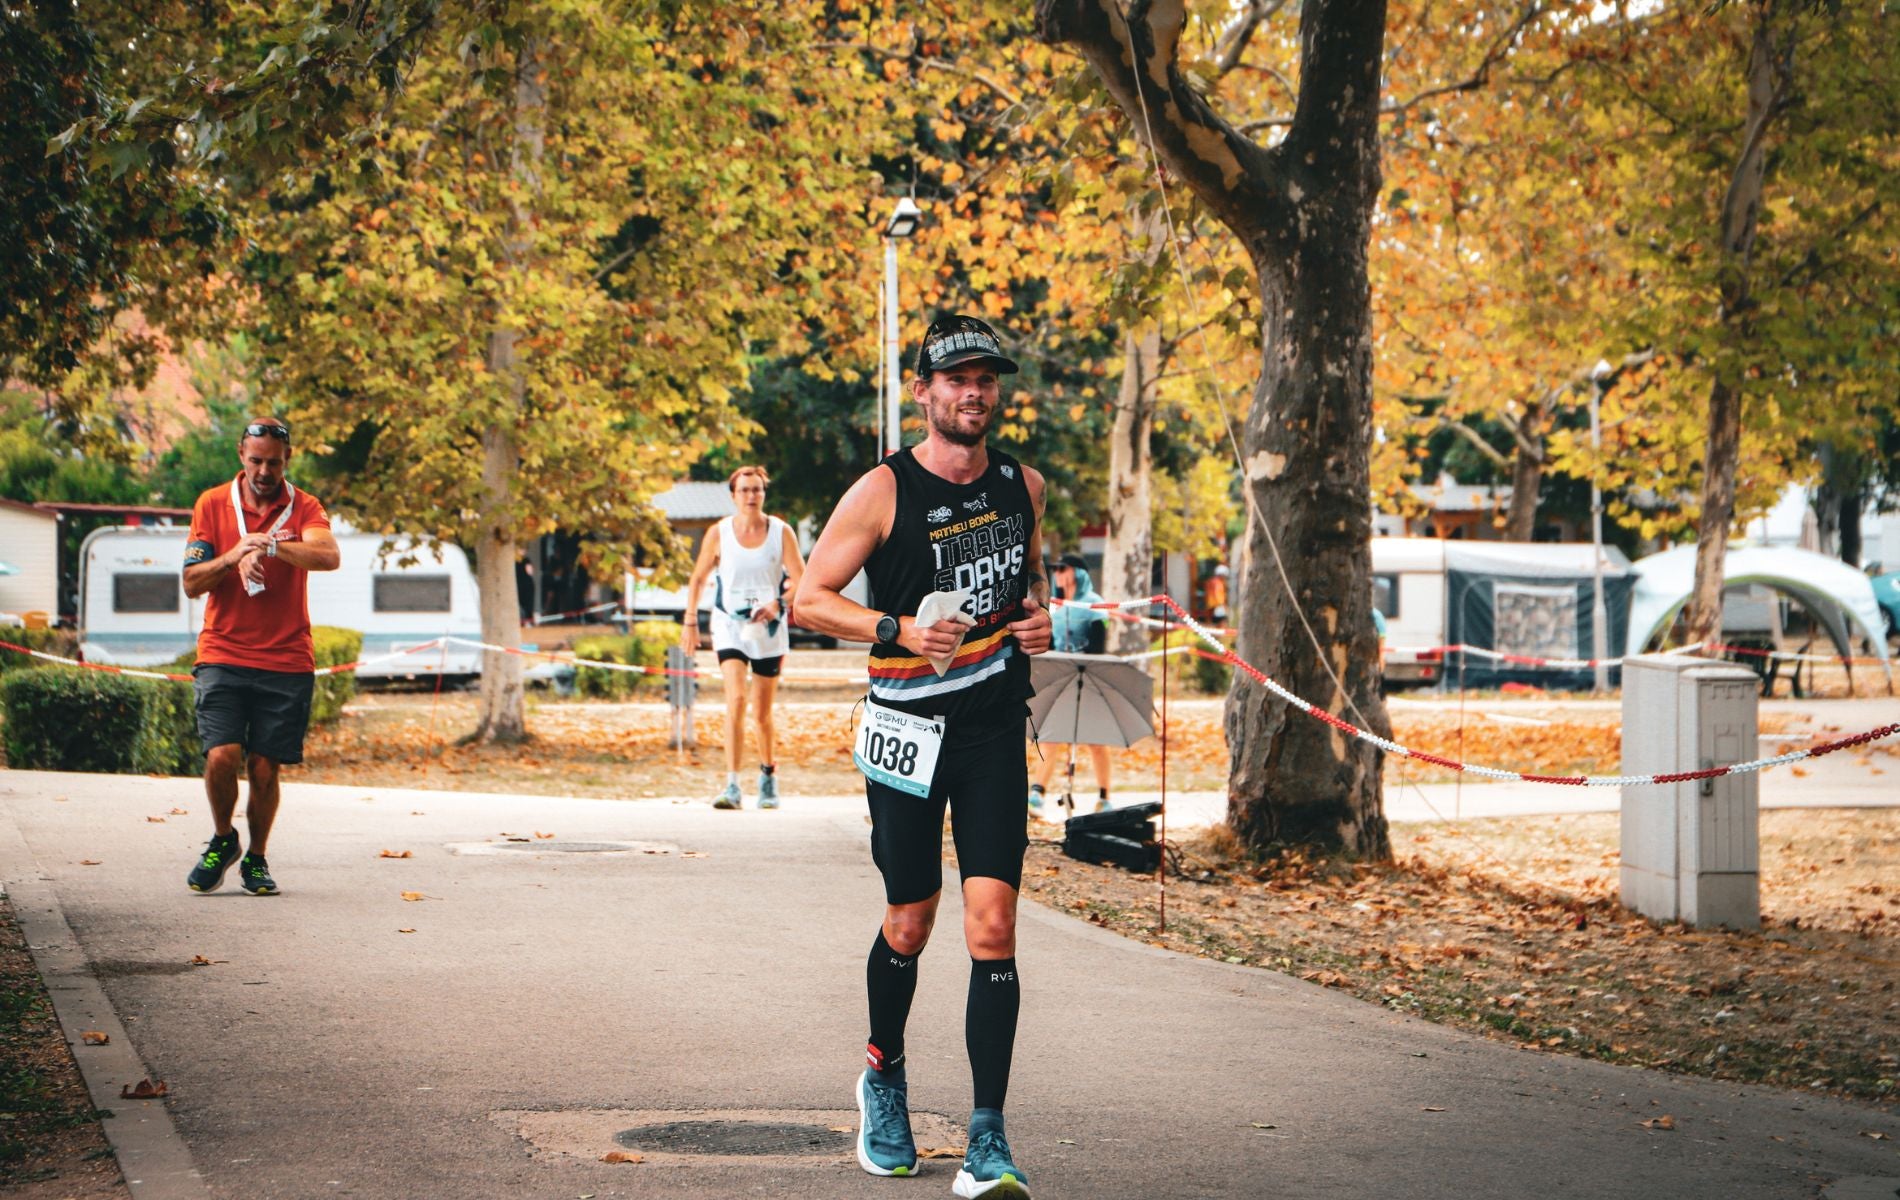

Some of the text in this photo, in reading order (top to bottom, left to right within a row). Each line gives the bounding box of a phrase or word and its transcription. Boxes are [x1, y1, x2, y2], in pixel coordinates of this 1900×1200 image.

[969, 510, 999, 528] BONNE
[863, 726, 919, 776] 1038
[991, 971, 1014, 982] RVE
